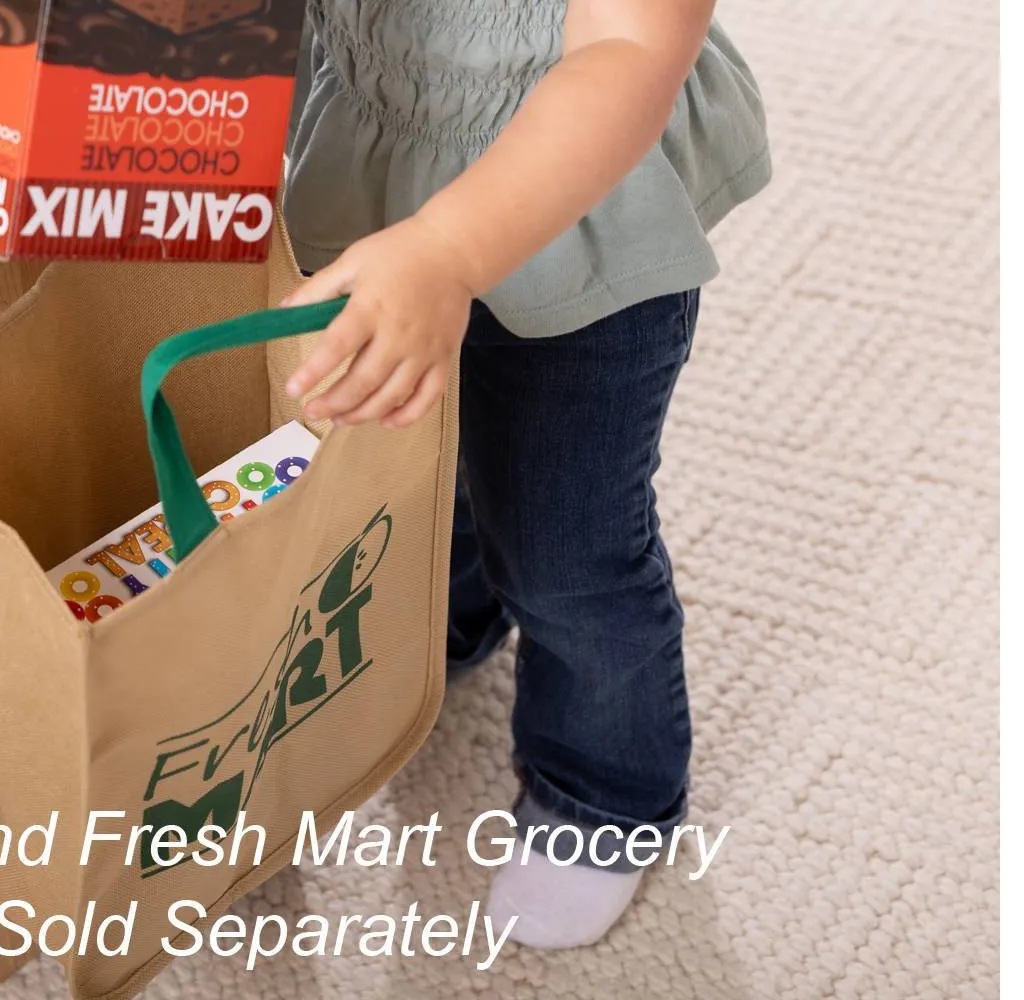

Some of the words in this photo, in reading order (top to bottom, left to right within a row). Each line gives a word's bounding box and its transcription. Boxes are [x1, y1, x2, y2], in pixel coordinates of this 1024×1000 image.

[89, 83, 249, 118] CHOCOLATE
[85, 114, 245, 147] CHOCOLATE
[81, 145, 240, 176] CHOCOLATE
[21, 185, 126, 239] MIX
[140, 188, 273, 243] CAKE
